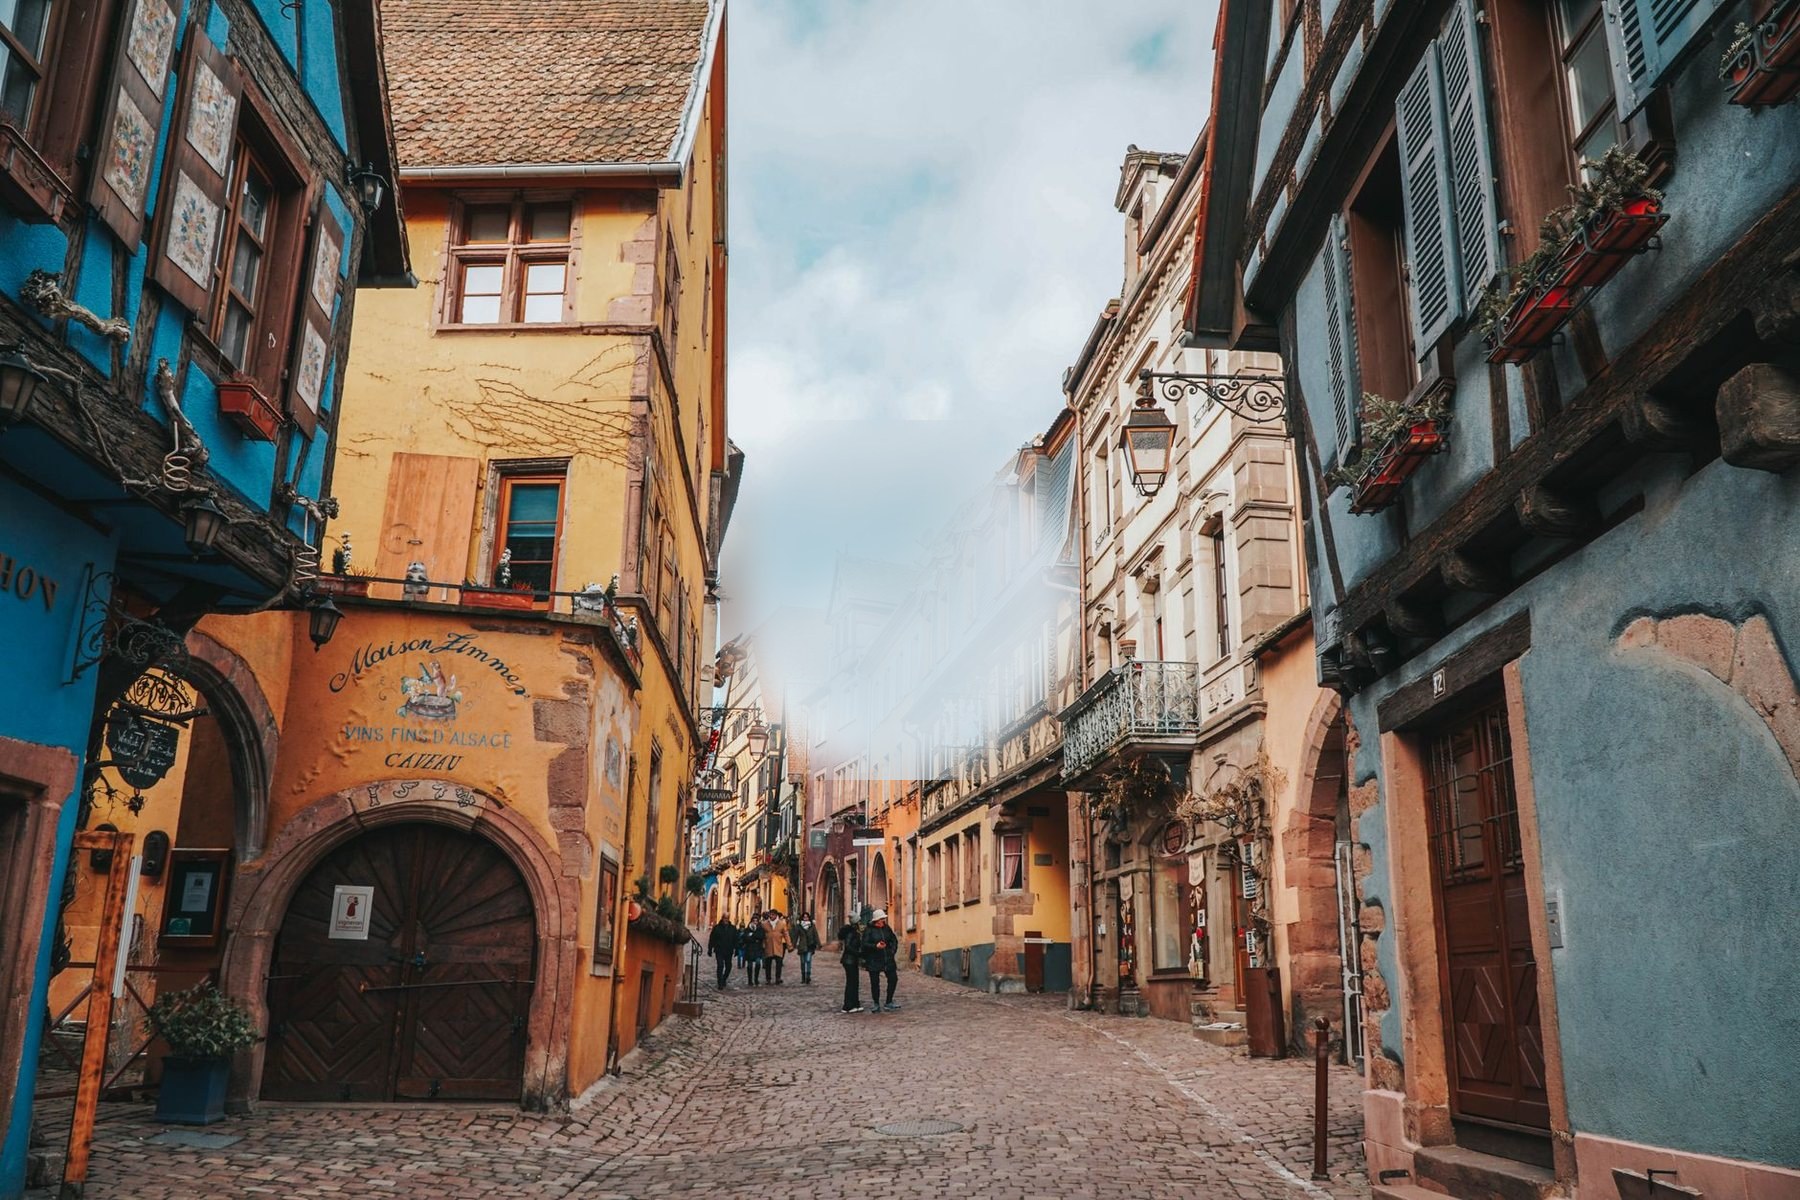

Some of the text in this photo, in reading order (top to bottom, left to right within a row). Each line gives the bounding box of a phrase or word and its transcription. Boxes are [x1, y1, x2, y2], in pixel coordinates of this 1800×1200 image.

[329, 632, 530, 698] Maison Zimmer
[345, 725, 384, 742] VINS
[391, 727, 428, 743] FINS
[384, 752, 463, 771] CAVEAU
